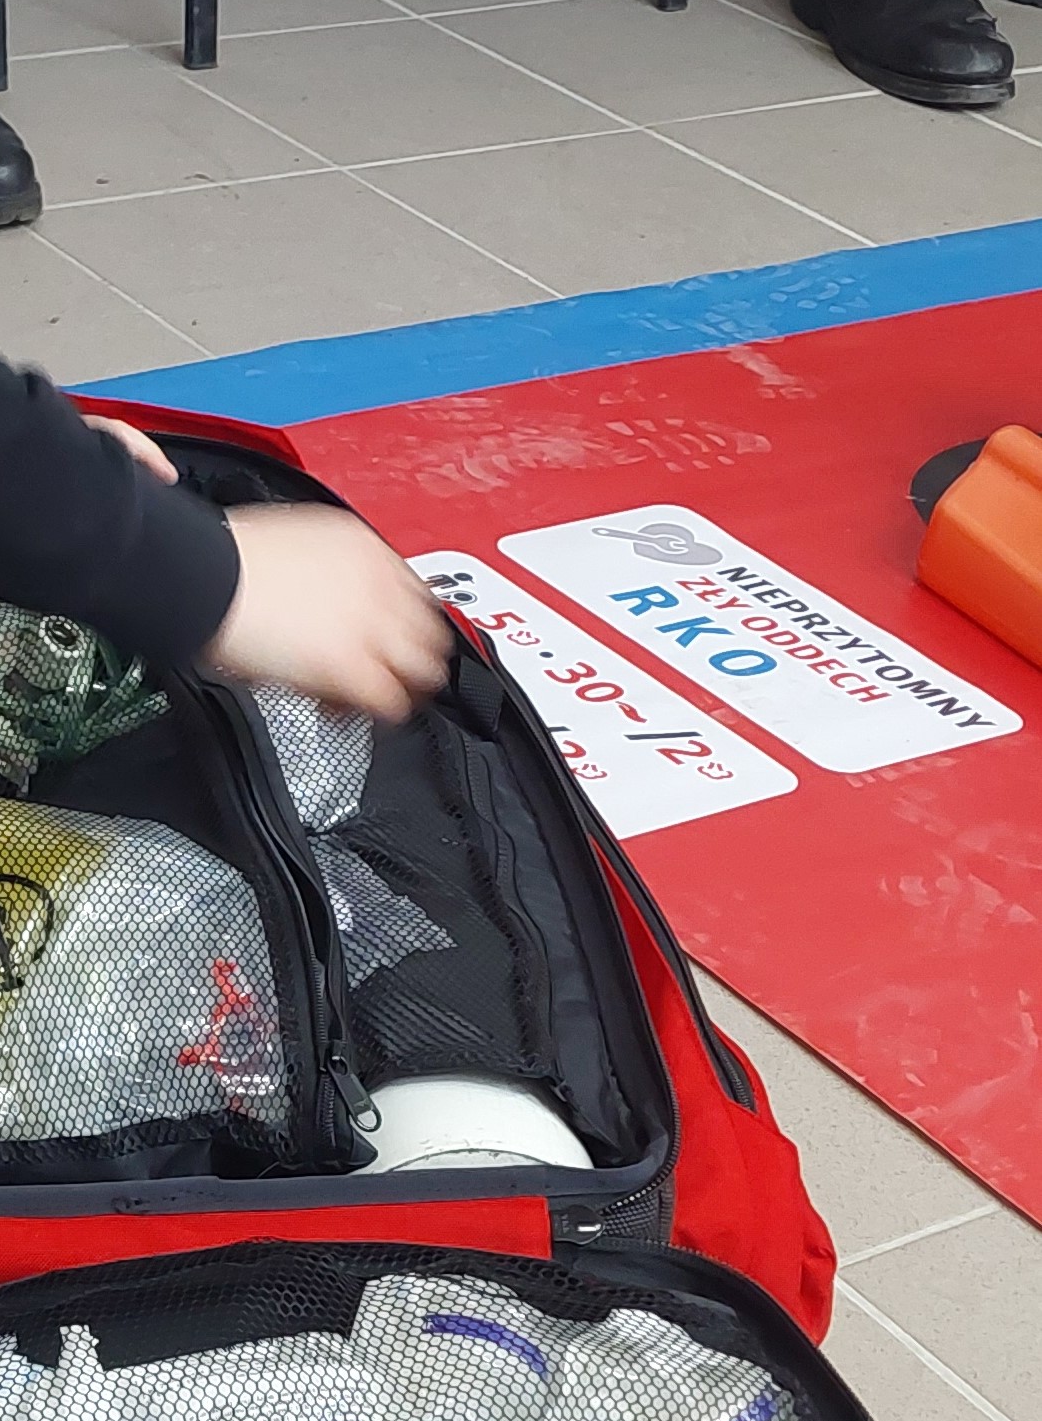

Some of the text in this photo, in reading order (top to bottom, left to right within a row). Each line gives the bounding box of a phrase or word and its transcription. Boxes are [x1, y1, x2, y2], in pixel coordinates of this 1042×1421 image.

[607, 585, 778, 677] RKO
[674, 576, 893, 703] ZŁY ODDECH
[716, 566, 998, 728] NIEPRZYTOMNY
